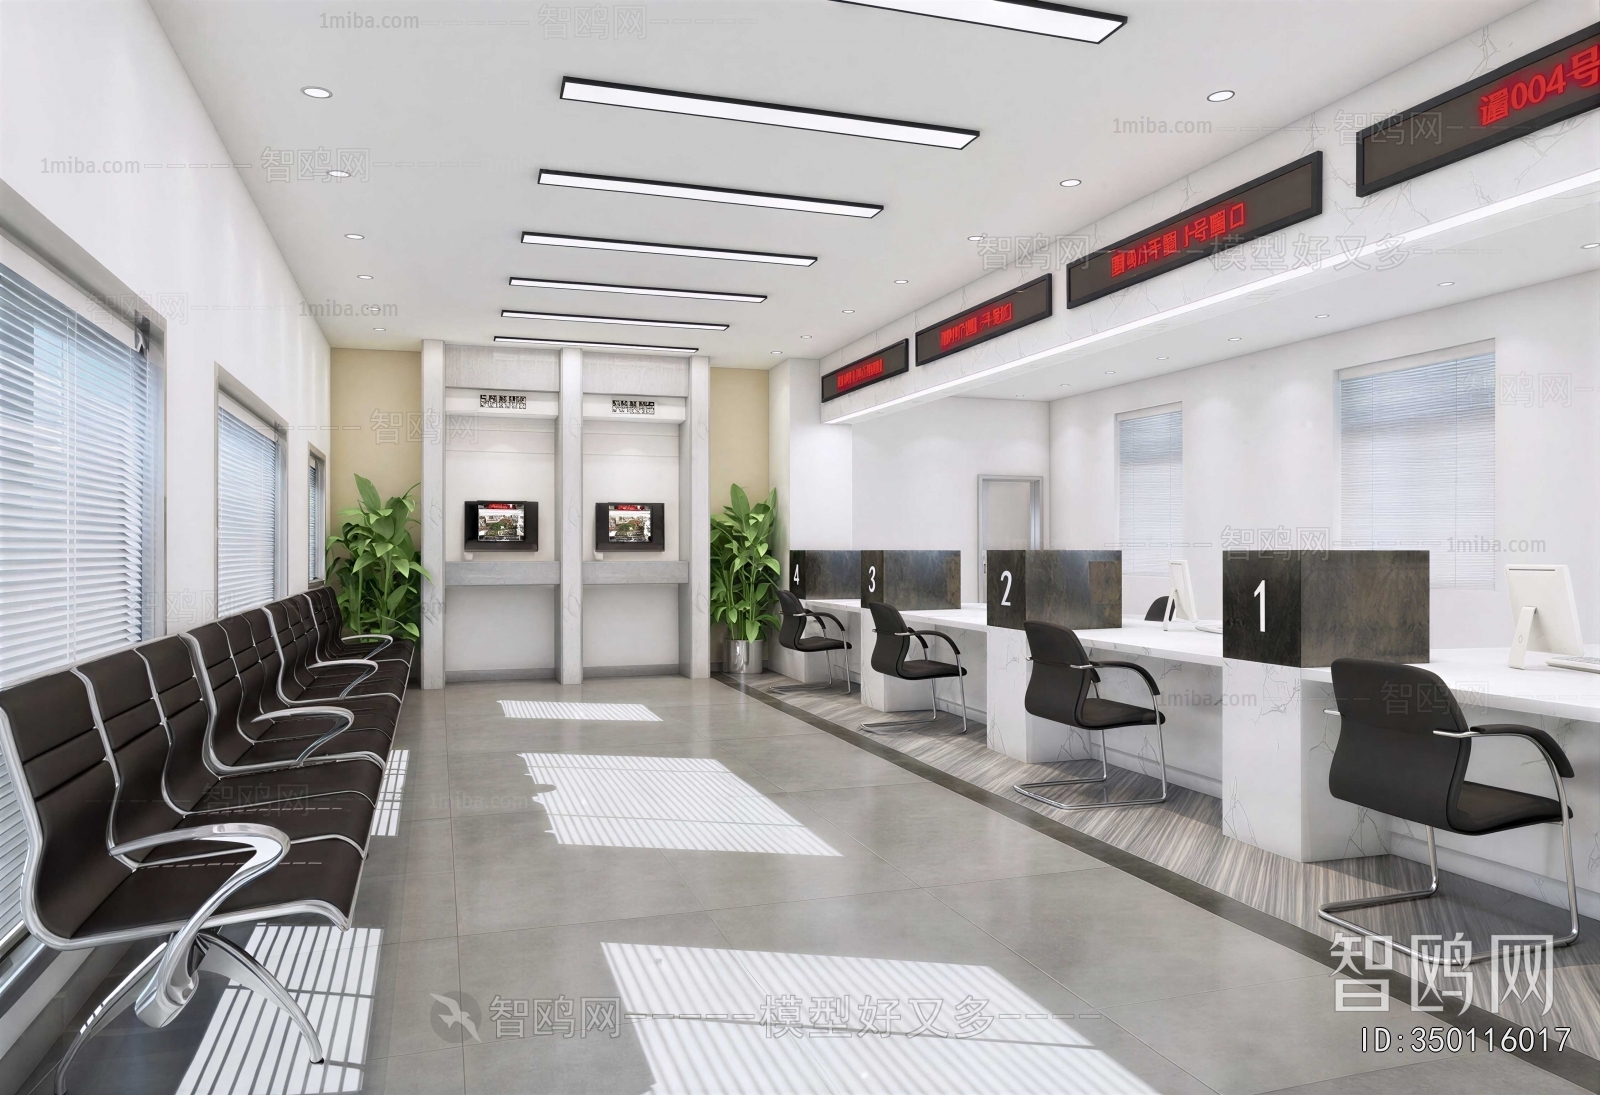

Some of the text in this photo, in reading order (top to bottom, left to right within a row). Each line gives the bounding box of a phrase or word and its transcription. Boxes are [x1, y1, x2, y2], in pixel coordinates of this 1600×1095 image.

[793, 564, 800, 586] 4
[868, 566, 876, 593] 3
[1000, 570, 1013, 606] 2
[1253, 579, 1266, 632] 1
